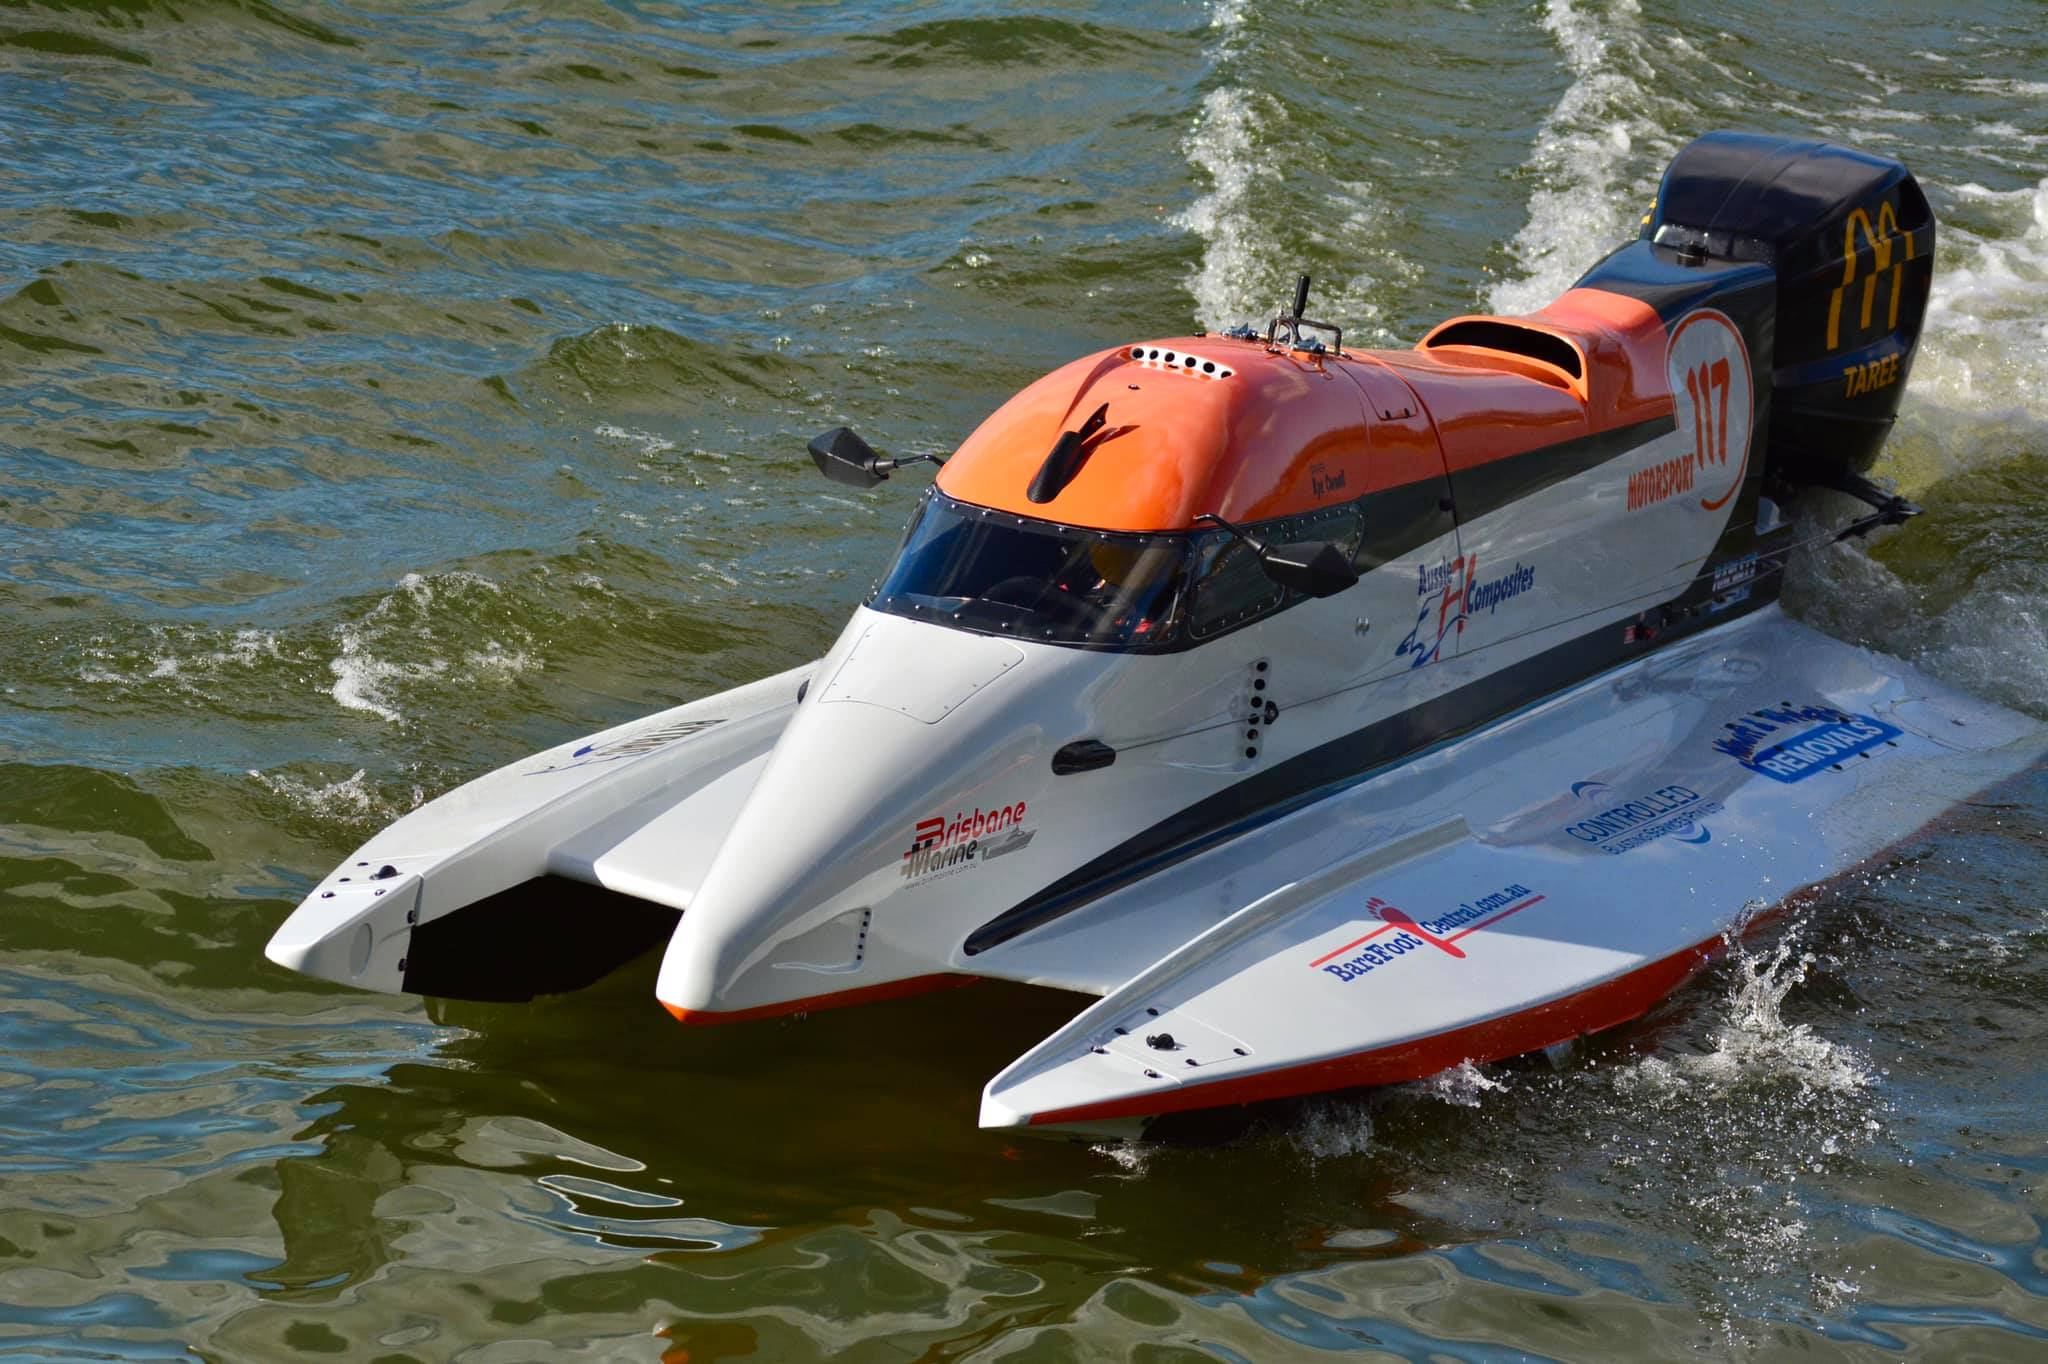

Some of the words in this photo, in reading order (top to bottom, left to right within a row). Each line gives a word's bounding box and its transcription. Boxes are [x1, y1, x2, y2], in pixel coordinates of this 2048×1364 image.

[1843, 352, 1899, 398] TAREE
[1687, 357, 1730, 471] 117
[1627, 453, 1694, 512] MOTORSPORT
[1418, 556, 1453, 596] Aussie
[1467, 562, 1535, 614] Composites
[1758, 721, 1885, 776] REMOVALS
[910, 801, 1026, 851] Brisbane
[1565, 785, 1700, 842] CONTROLLED
[904, 840, 978, 879] Marine
[1323, 931, 1424, 983] BareFoot
[1419, 883, 1533, 935] Central.com.au
